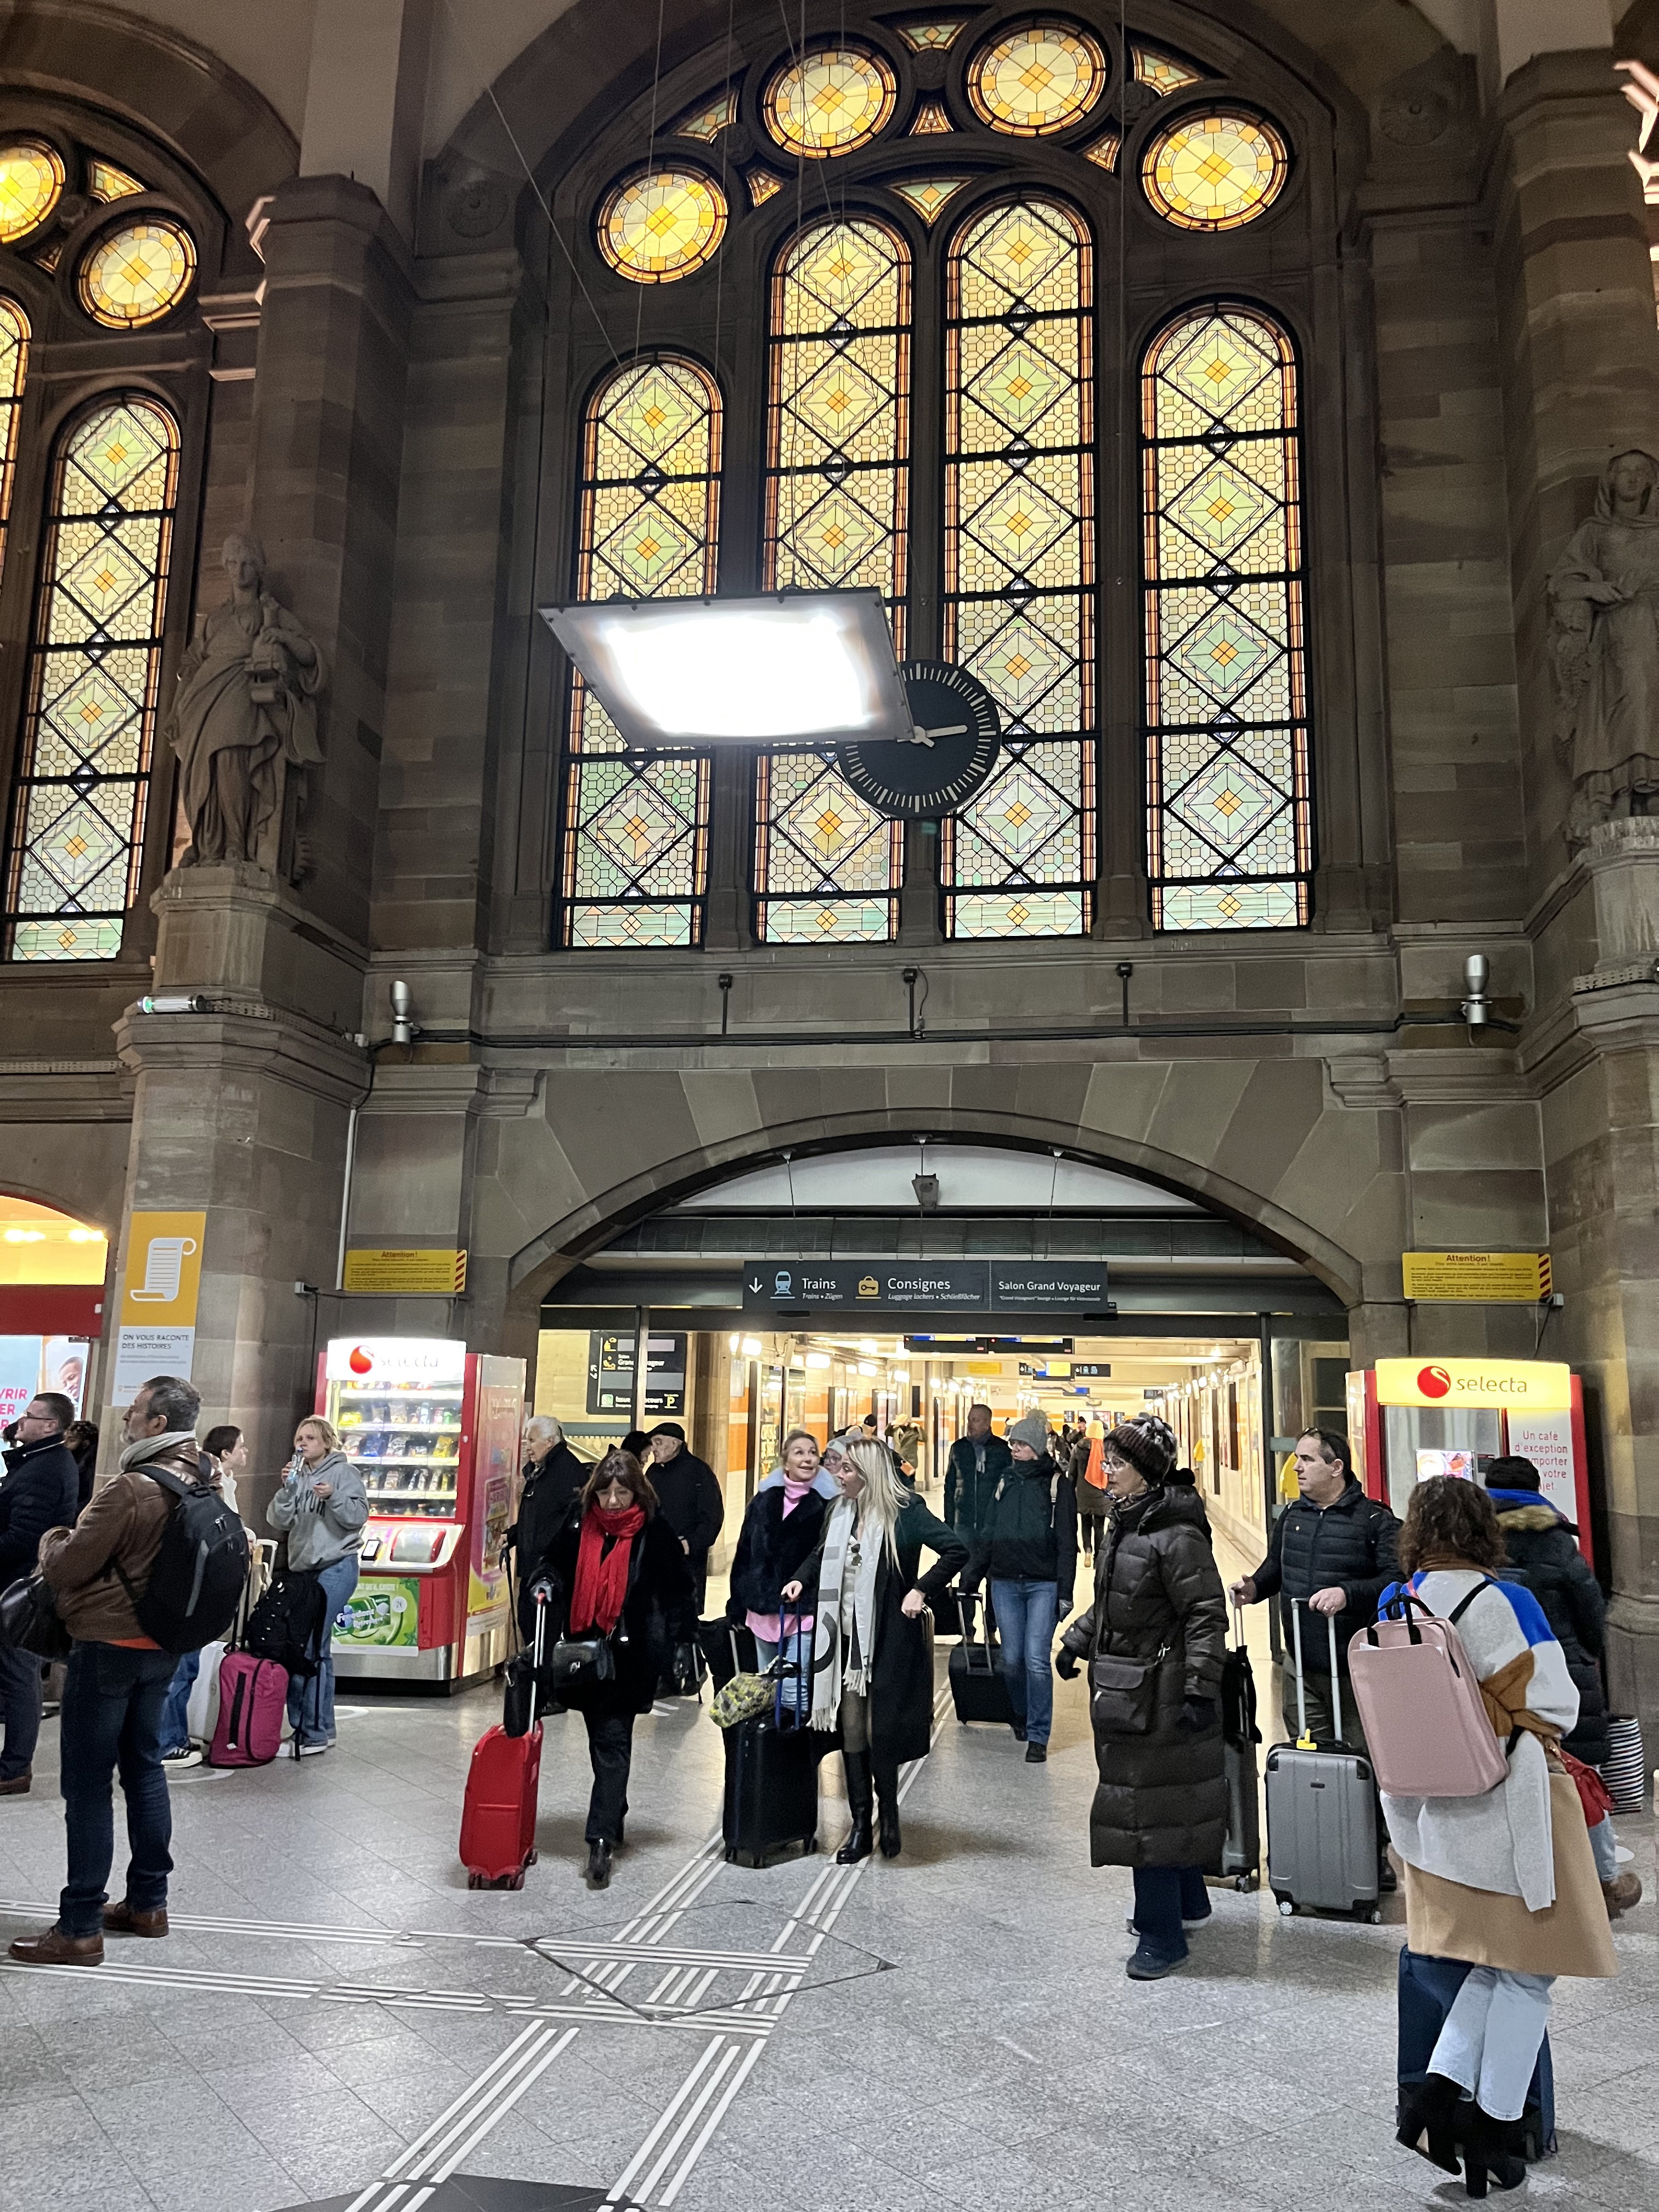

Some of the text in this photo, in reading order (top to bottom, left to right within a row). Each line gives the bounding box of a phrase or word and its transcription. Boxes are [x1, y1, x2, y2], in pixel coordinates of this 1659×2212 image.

[802, 1278, 836, 1289] Trains
[888, 1278, 951, 1293] Consignes
[998, 1281, 1101, 1293] Salon Grand Voyageur
[1455, 1376, 1527, 1392] selecta
[1523, 1430, 1558, 1441] Un café
[1515, 1442, 1568, 1454] d'exception
[1530, 1457, 1567, 1467] mporter
[1543, 1470, 1566, 1478] votre
[1539, 1482, 1558, 1492] jet.
